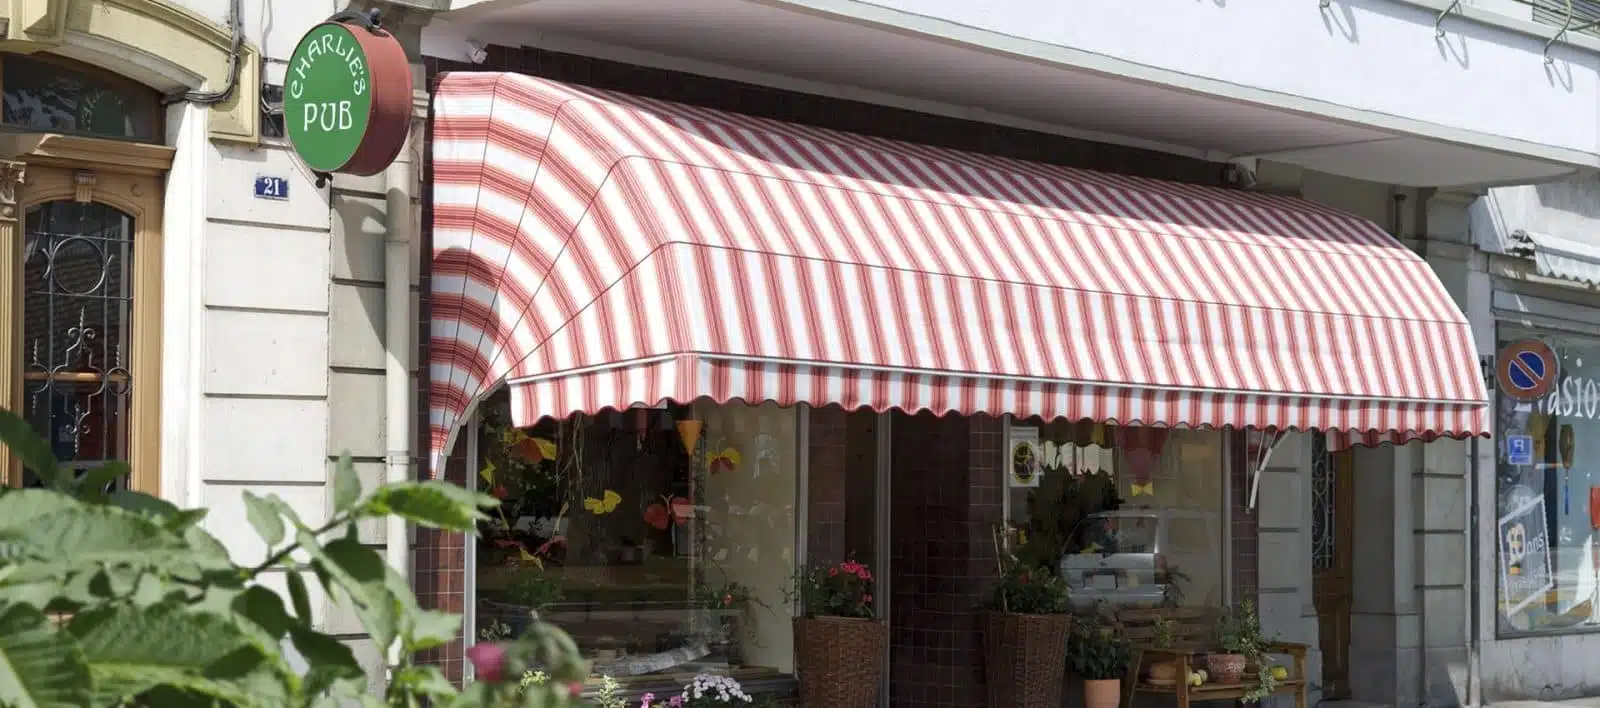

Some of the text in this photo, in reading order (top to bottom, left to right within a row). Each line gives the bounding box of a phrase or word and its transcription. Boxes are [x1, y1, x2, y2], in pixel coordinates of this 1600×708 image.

[291, 34, 366, 99] CHARLIE'S
[303, 100, 353, 132] PUB
[263, 177, 280, 196] 21
